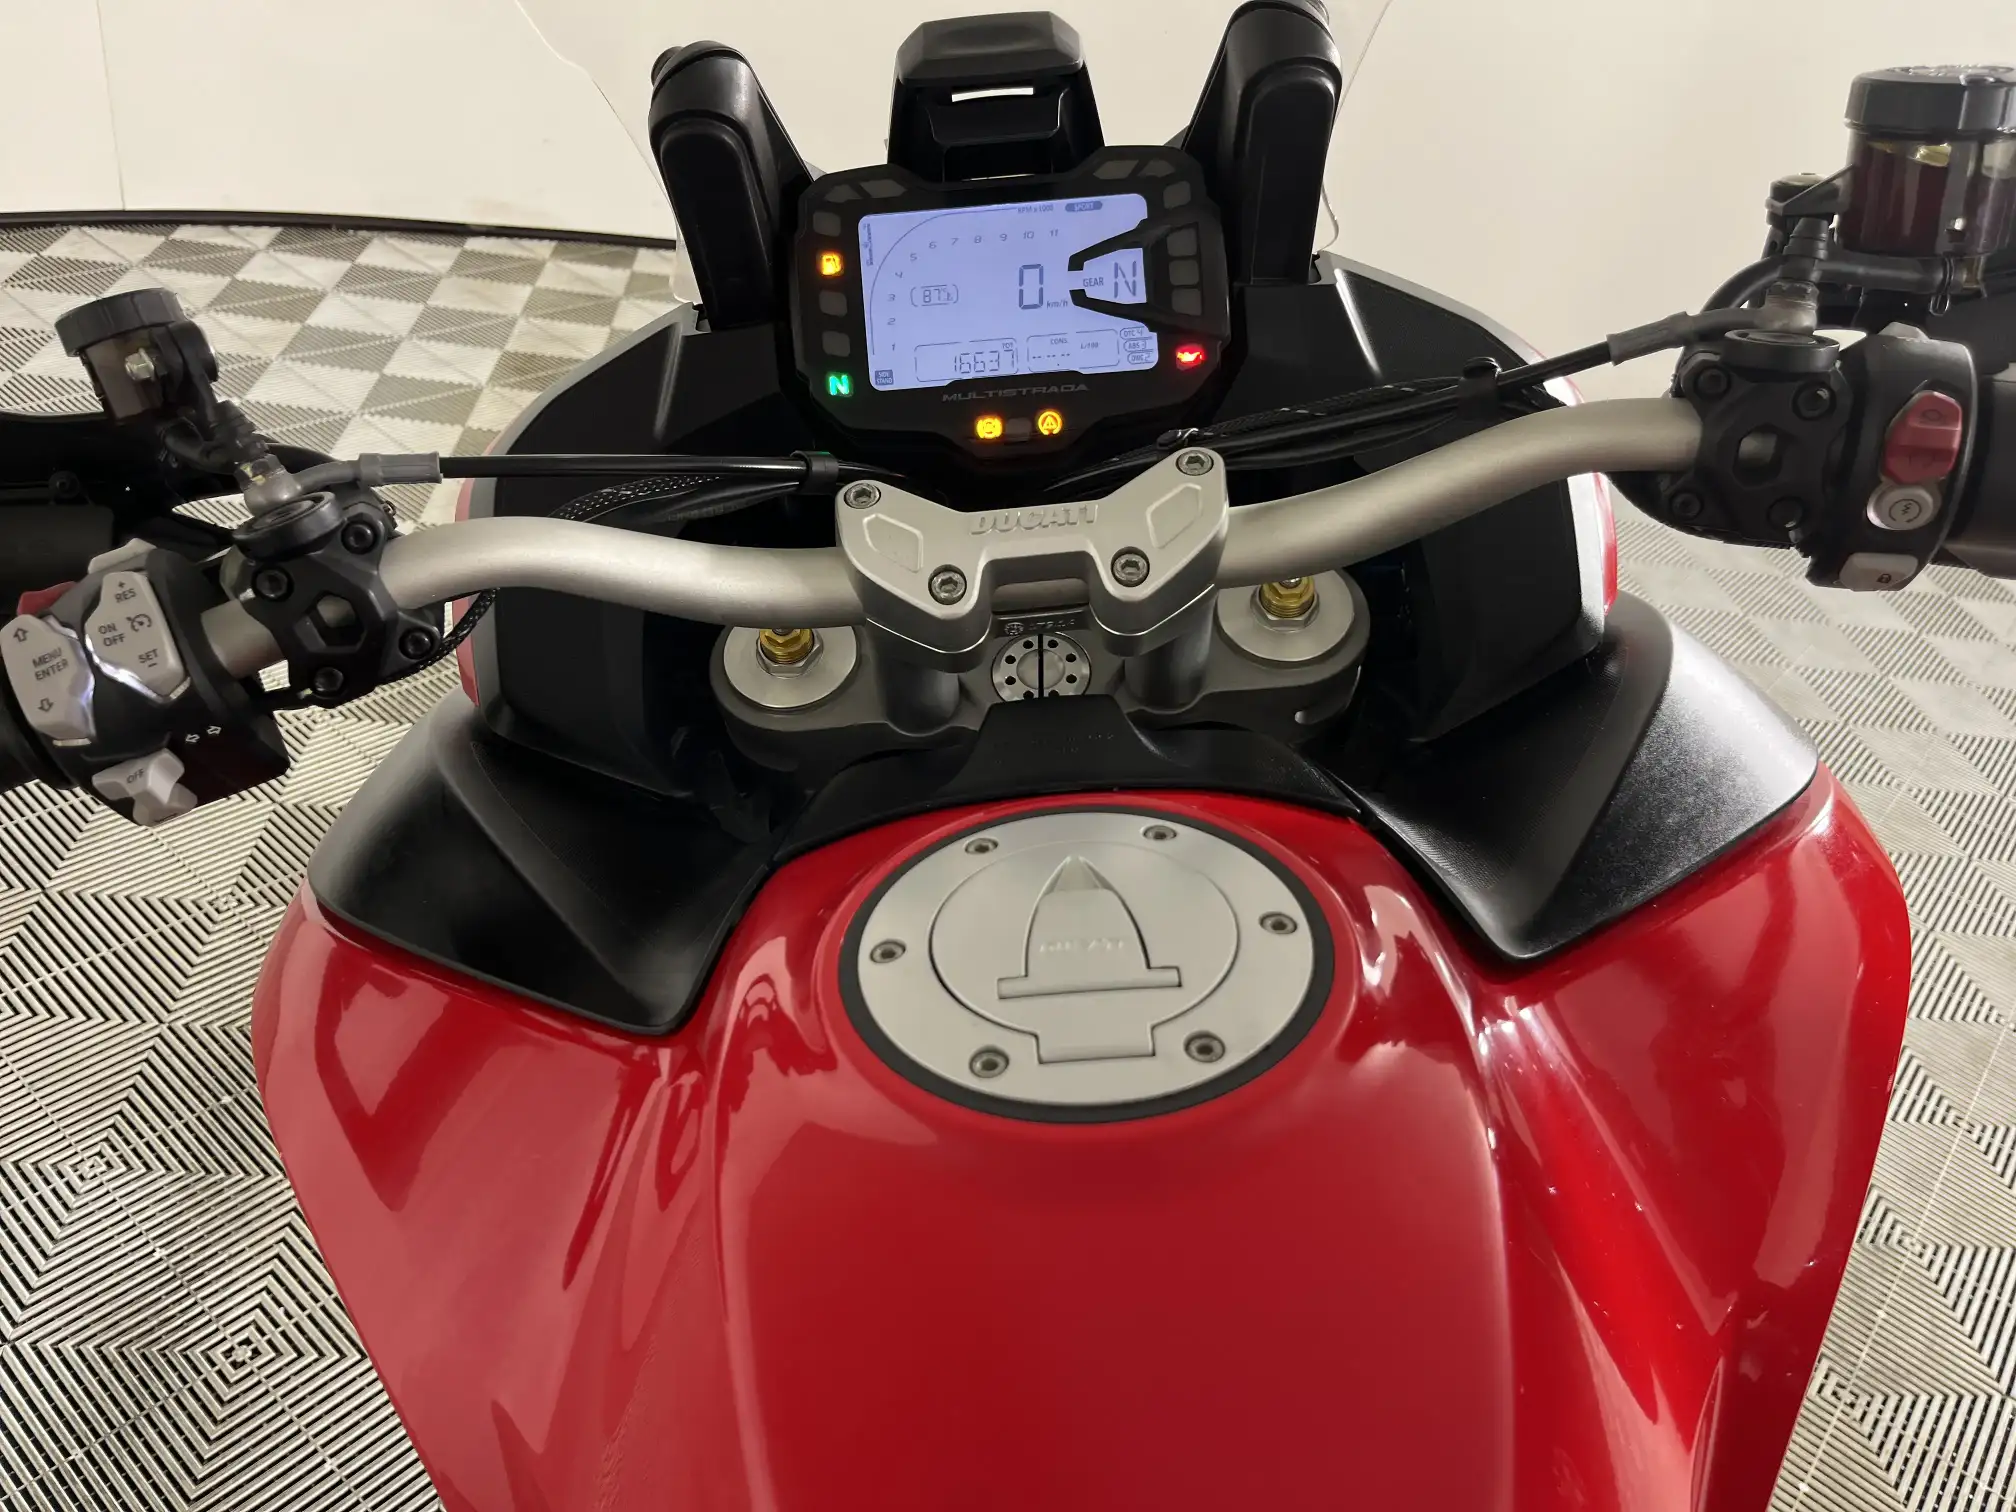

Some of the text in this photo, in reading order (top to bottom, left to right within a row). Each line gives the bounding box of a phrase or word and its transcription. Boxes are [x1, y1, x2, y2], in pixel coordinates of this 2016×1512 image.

[1074, 203, 1094, 211] SPORT
[1000, 233, 1007, 241] 9
[1023, 231, 1034, 239] 10
[1050, 229, 1059, 237] 11
[951, 237, 960, 245] 7
[974, 235, 982, 244] 8
[928, 241, 937, 249] 6
[910, 253, 918, 262] 5
[895, 271, 903, 279] 4
[1114, 260, 1137, 299] N
[1019, 263, 1044, 309] 0
[1083, 277, 1104, 287] GEAR
[888, 293, 896, 301] 3
[1046, 300, 1068, 309] km/h
[887, 318, 896, 326] 2
[891, 343, 896, 351] 1
[954, 350, 1015, 375] 16637
[828, 373, 850, 396] N
[942, 383, 1089, 402] MULTISTRADA
[970, 503, 1098, 535] DUCATI
[114, 588, 137, 603] RES
[98, 623, 117, 635] ON
[103, 633, 126, 647] OFF
[32, 647, 63, 668] MENU
[138, 649, 158, 663] SET
[35, 659, 69, 681] ENTER
[126, 768, 145, 784] OFF
